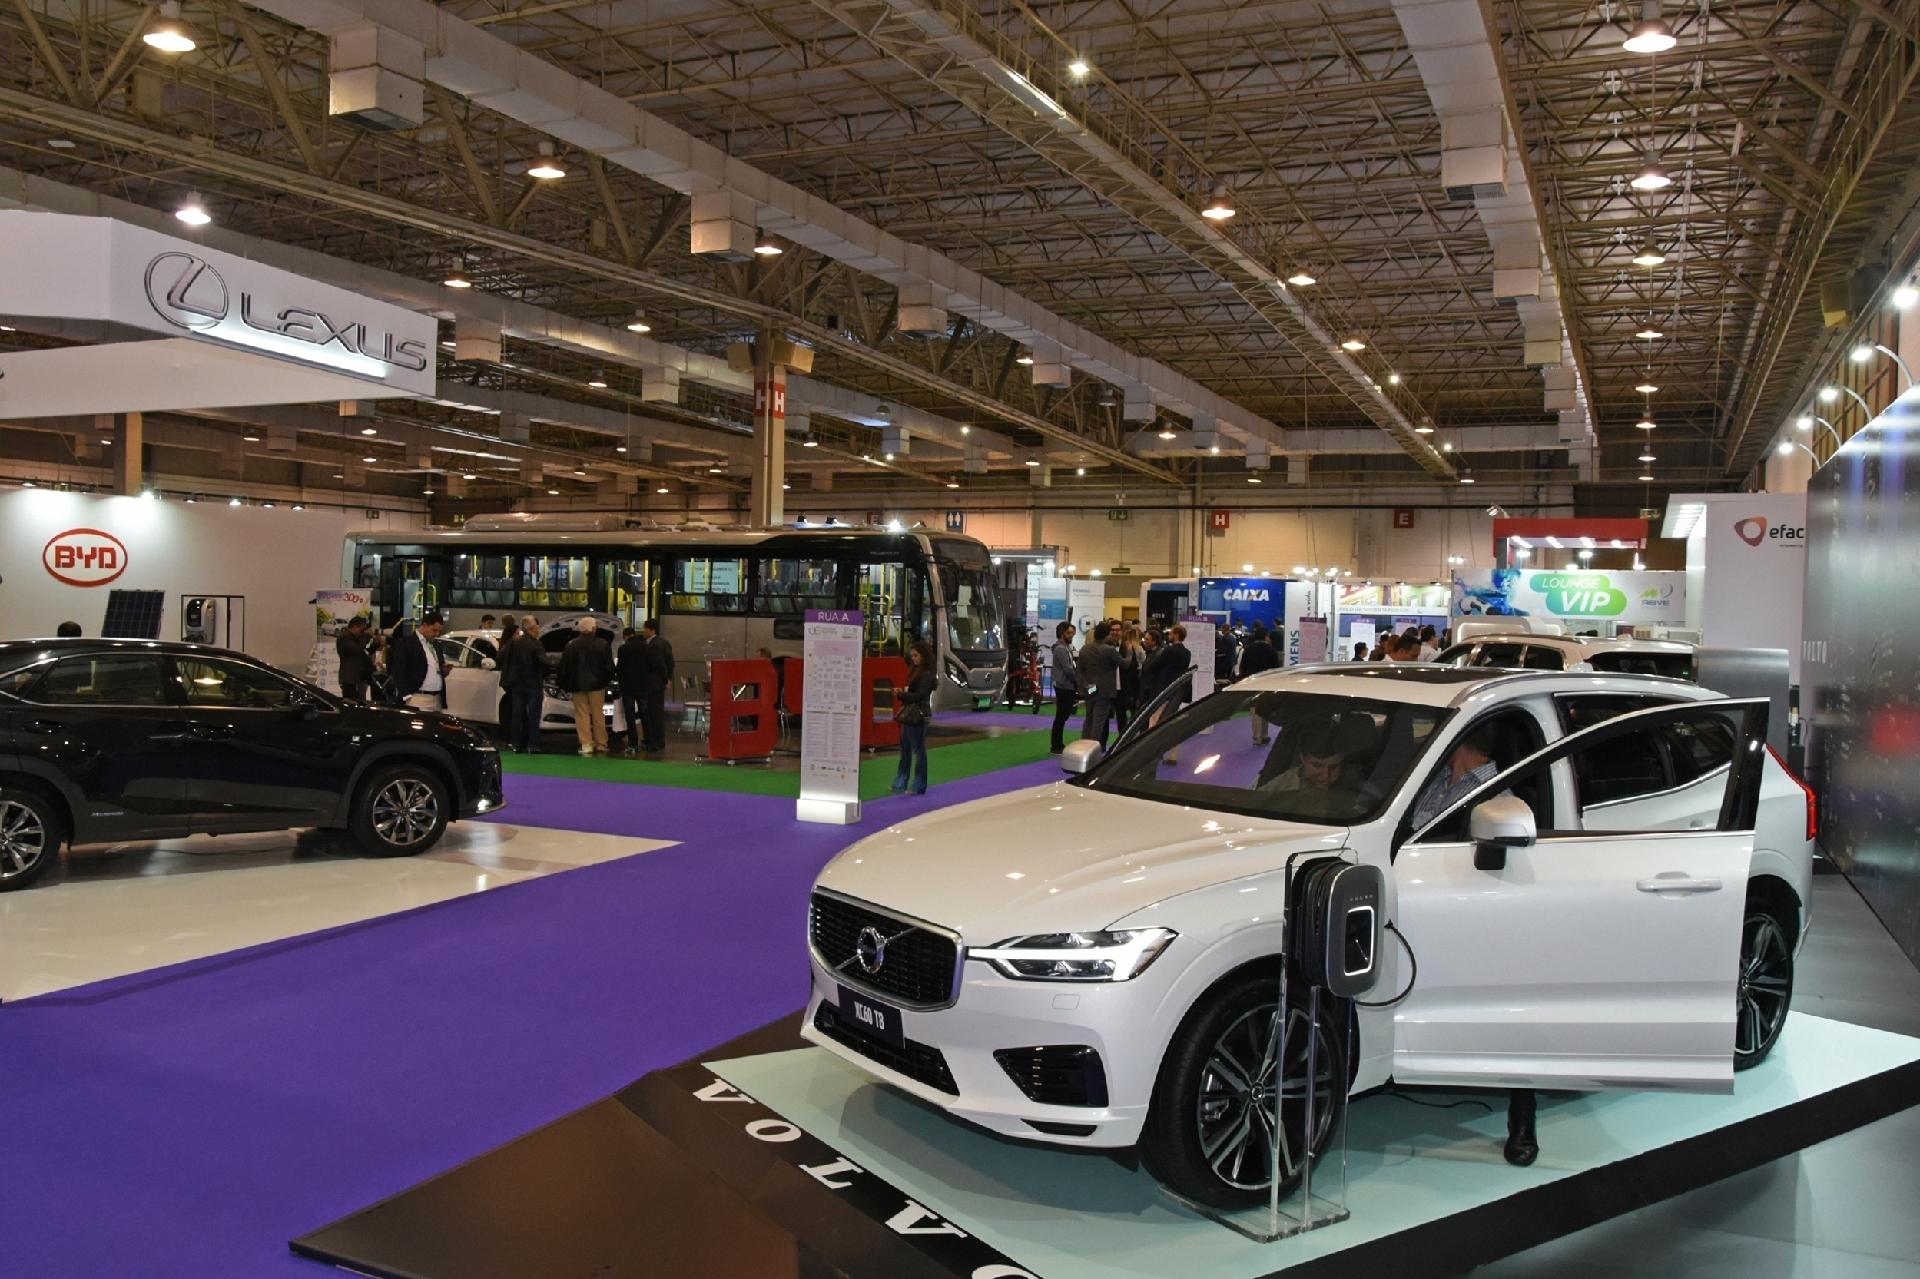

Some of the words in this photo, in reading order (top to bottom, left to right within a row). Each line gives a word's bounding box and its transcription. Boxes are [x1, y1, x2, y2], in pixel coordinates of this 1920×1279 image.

[240, 290, 428, 372] LEXUS
[774, 391, 785, 413] H
[1215, 514, 1225, 526] H
[1399, 513, 1409, 525] E
[54, 545, 117, 570] BYD
[1542, 577, 1601, 589] LOUNGE
[1223, 588, 1270, 602] CAIXA
[1560, 591, 1611, 612] VIP
[817, 611, 838, 622] RUA
[841, 613, 849, 622] A
[854, 1001, 873, 1025] XC60
